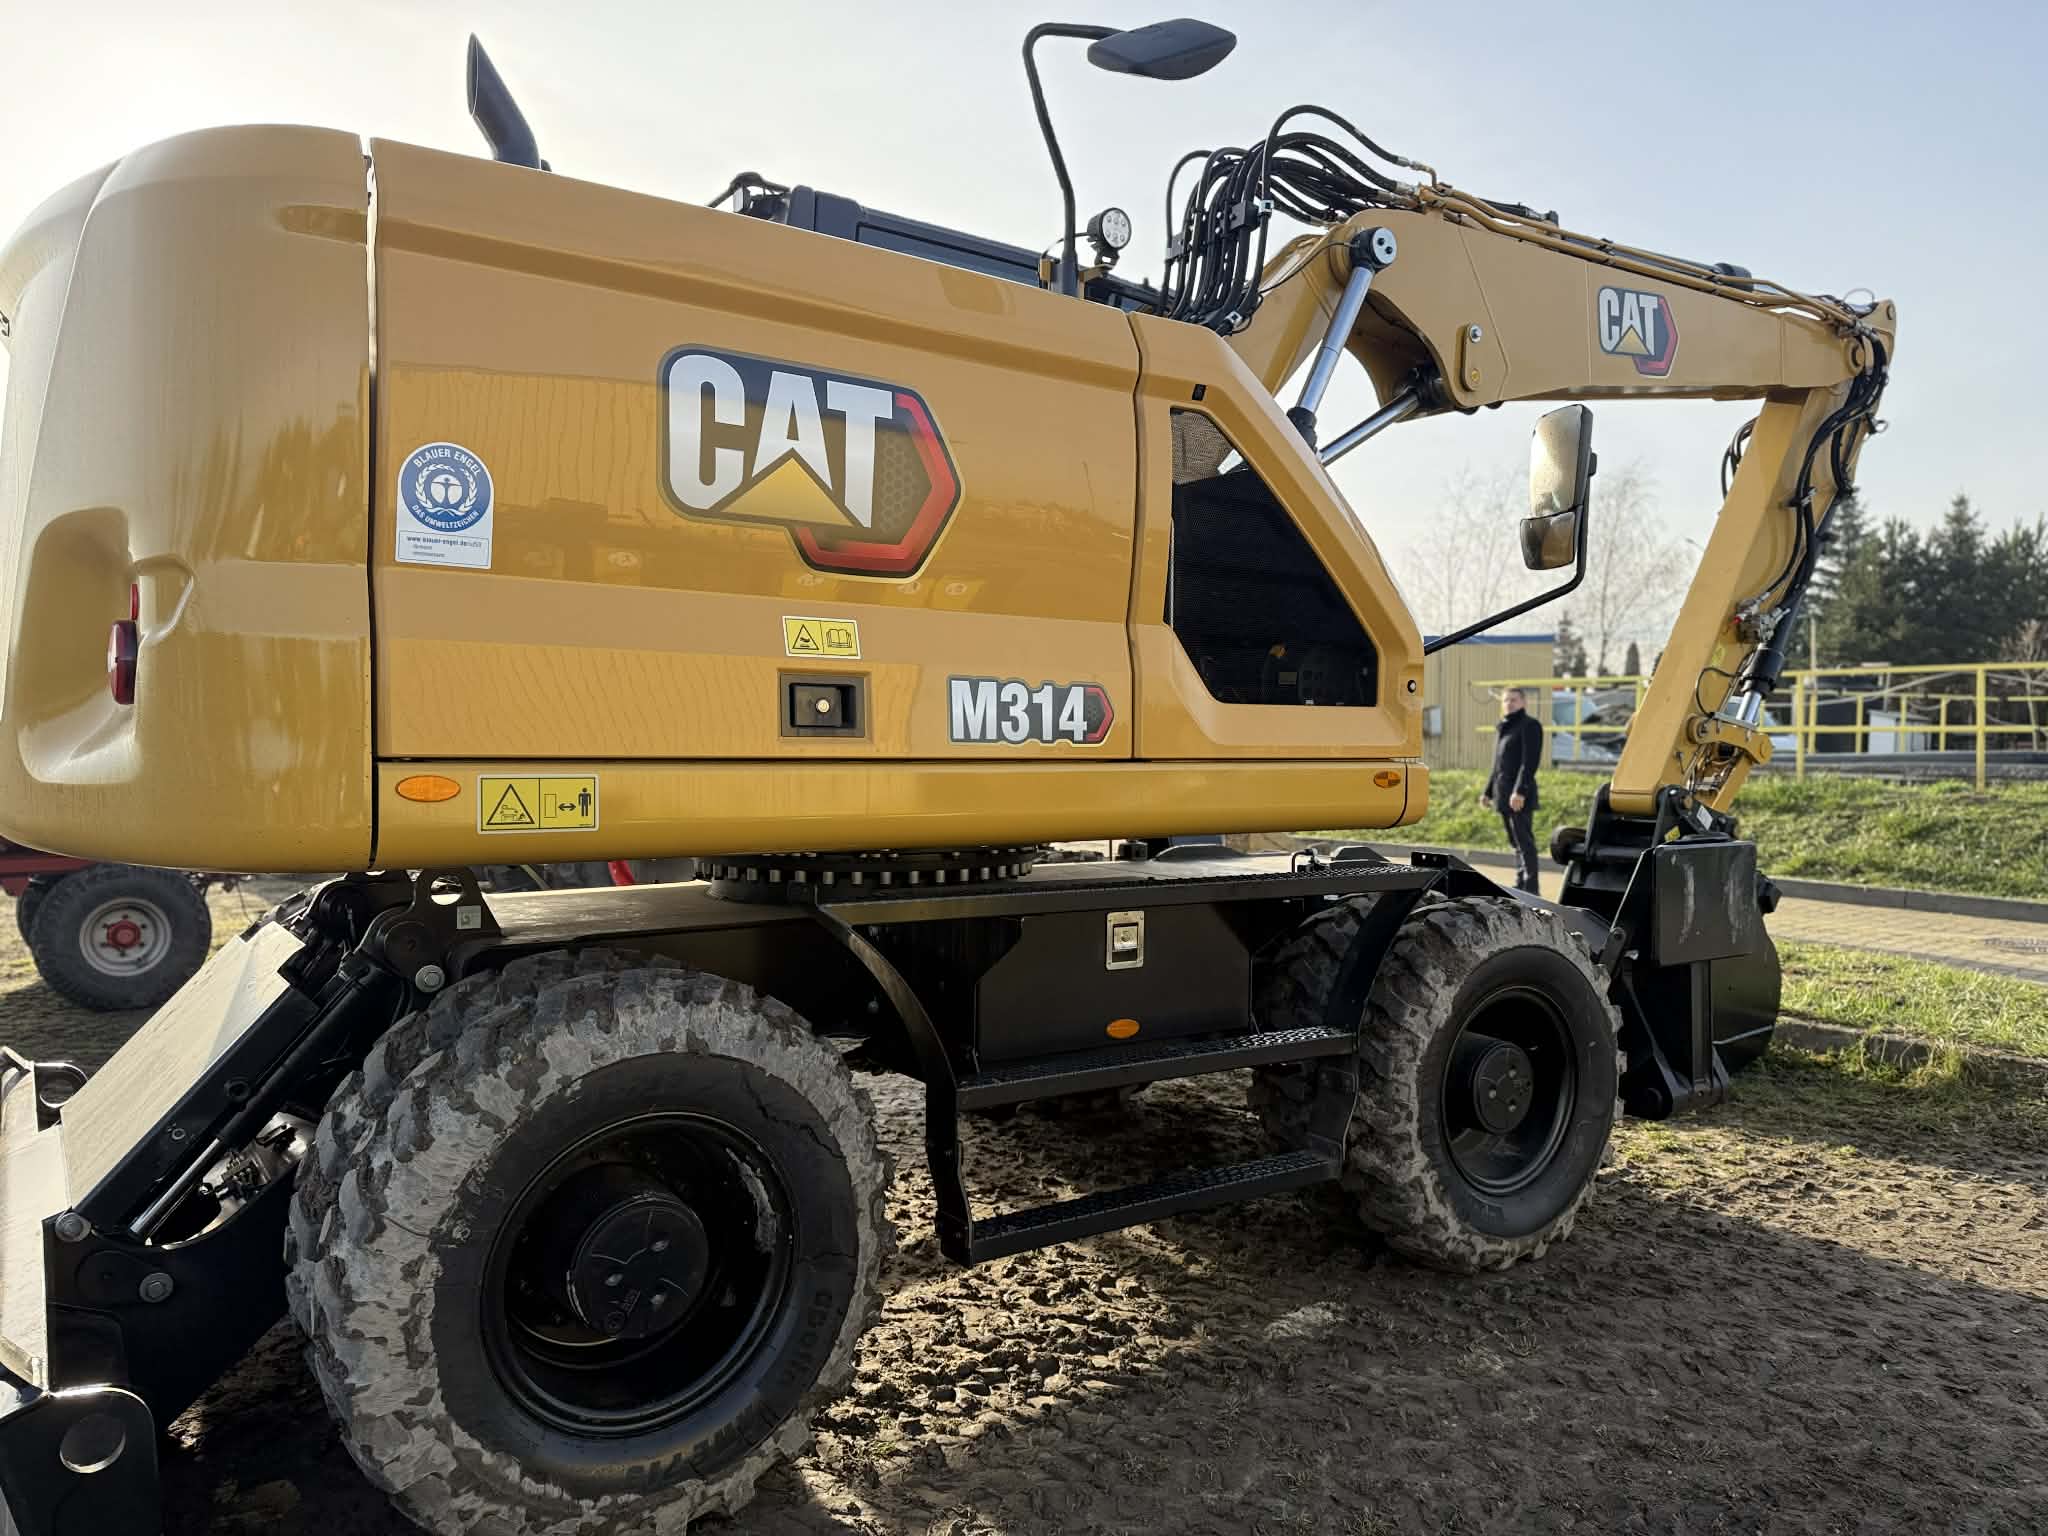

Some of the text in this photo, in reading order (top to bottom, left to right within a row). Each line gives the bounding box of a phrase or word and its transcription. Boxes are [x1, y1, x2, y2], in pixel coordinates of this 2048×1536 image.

[1599, 288, 1658, 356] CAT
[413, 448, 481, 477] BLAUER ENGEL
[669, 354, 893, 529] CAT
[412, 504, 480, 529] DAS UMWELTZEICHEN
[950, 679, 1088, 744] M314
